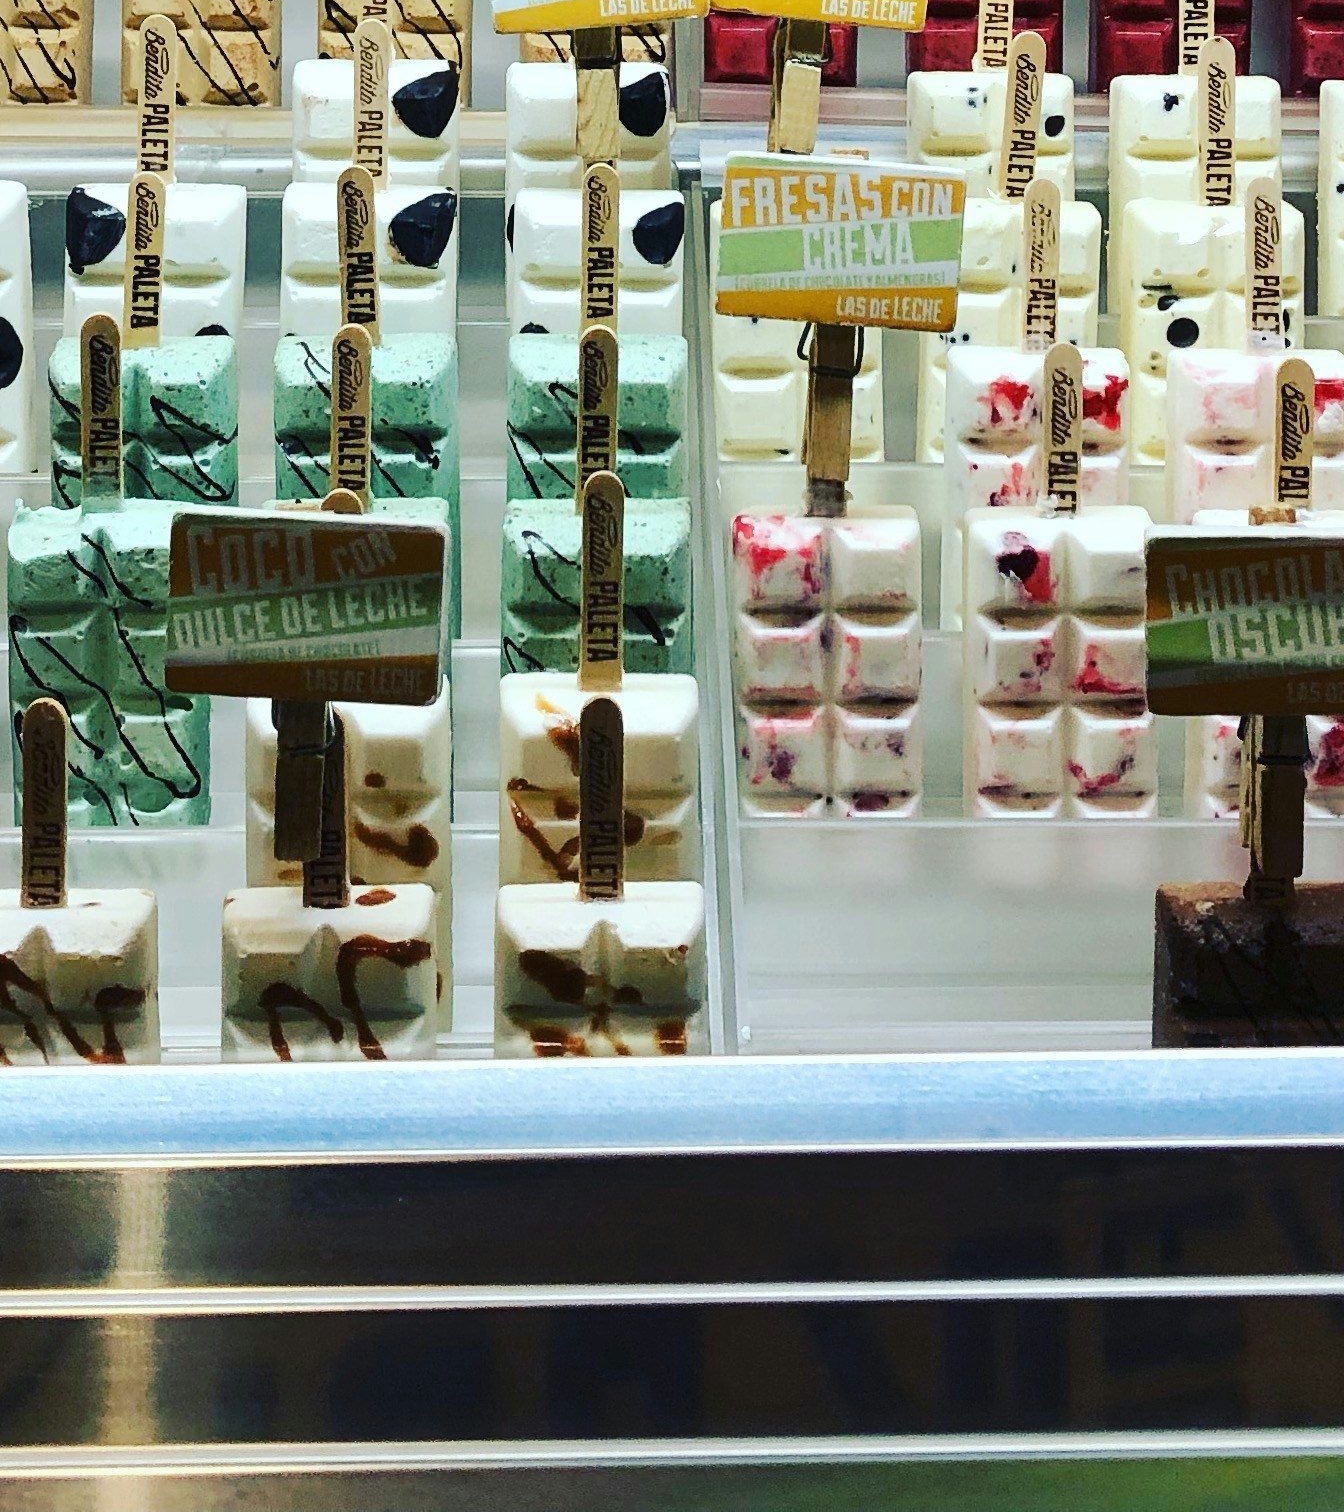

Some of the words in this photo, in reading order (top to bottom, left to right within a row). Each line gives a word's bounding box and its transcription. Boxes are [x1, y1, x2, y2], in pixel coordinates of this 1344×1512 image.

[852, 0, 870, 18] DE
[872, 0, 917, 24] LECHE
[730, 173, 884, 227] FRESAS
[891, 180, 953, 219] CON
[802, 221, 914, 271] CREMA
[586, 247, 613, 318] PALETA
[188, 525, 315, 596] COCO
[330, 531, 396, 582] CON
[174, 600, 276, 650] DULCE
[280, 594, 323, 635] DE
[328, 579, 428, 628] LECHE
[588, 580, 620, 663] PALETA
